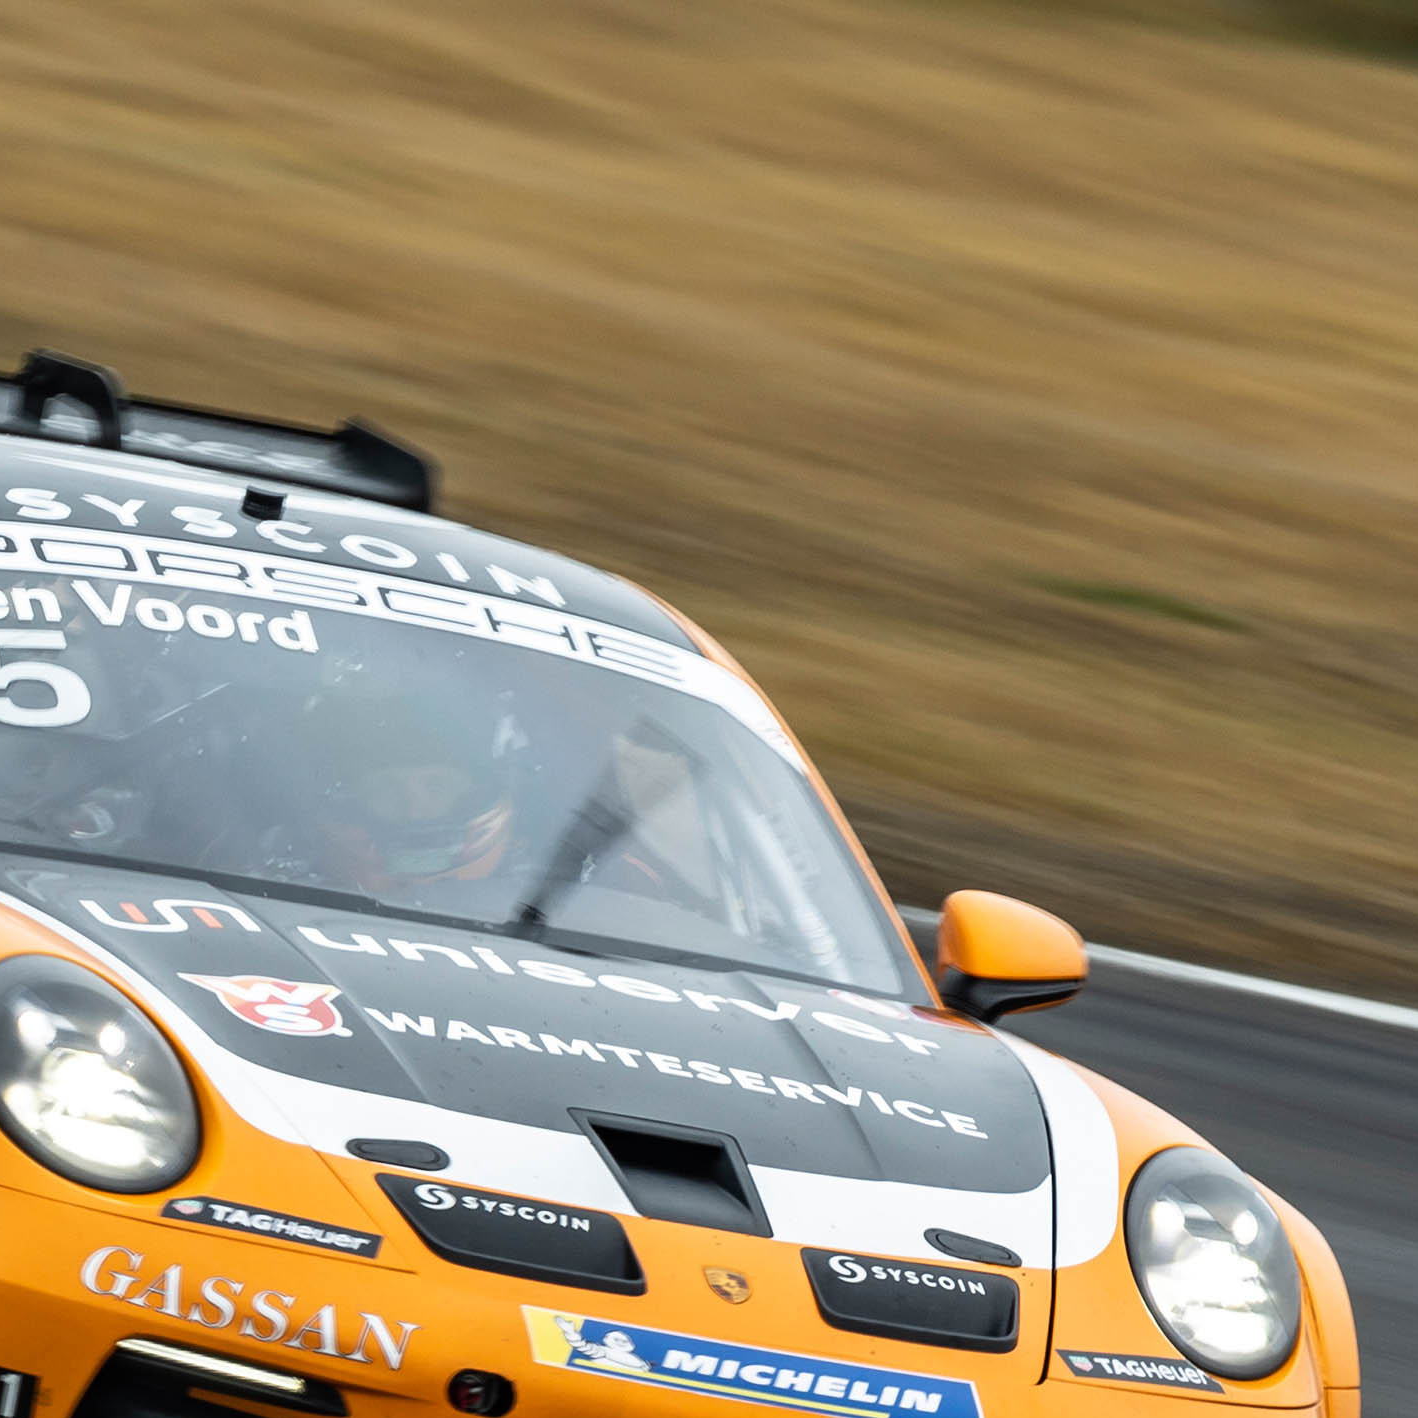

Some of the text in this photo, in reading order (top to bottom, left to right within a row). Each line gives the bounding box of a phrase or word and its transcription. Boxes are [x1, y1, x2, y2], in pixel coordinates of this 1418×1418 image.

[4, 487, 567, 608] SYSCOIN
[71, 579, 320, 654] Voord
[297, 925, 940, 1056] uniserver
[363, 1008, 989, 1140] WARMTESERVICE
[461, 1194, 591, 1232] SYSCOIN
[80, 1245, 421, 1371] GASSAN
[873, 1265, 987, 1297] SYSCOIN
[662, 1349, 943, 1414] MICHELIN
